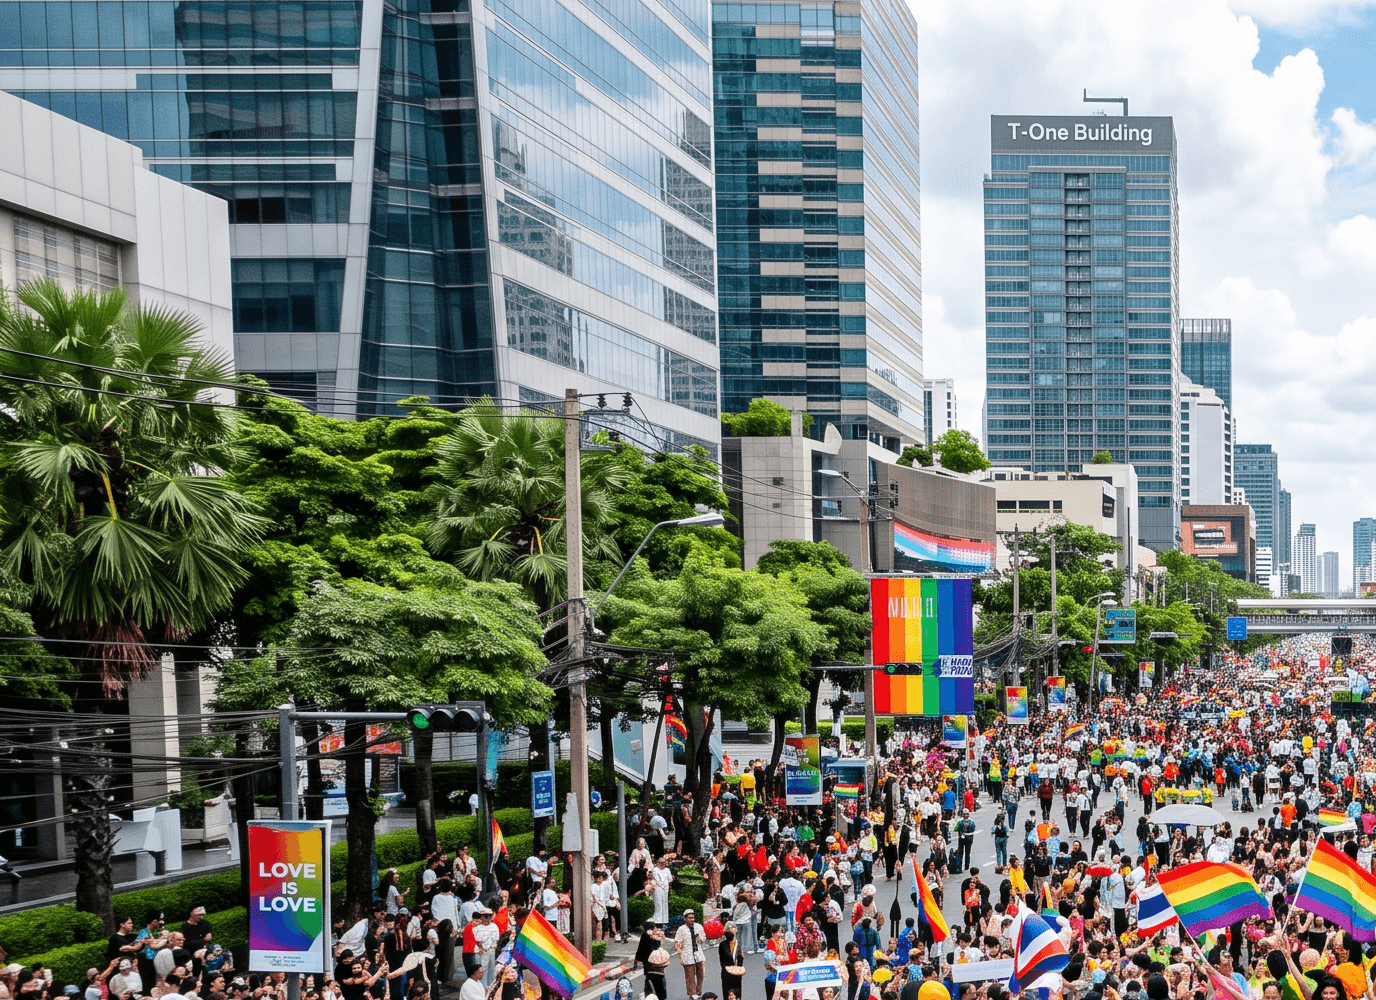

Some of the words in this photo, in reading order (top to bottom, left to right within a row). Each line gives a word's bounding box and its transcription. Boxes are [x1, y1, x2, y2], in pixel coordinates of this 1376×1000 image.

[1007, 122, 1069, 141] T-One
[1074, 123, 1153, 146] Building
[259, 862, 316, 878] LOVE
[281, 882, 298, 895] IS
[259, 896, 316, 913] LOVE
